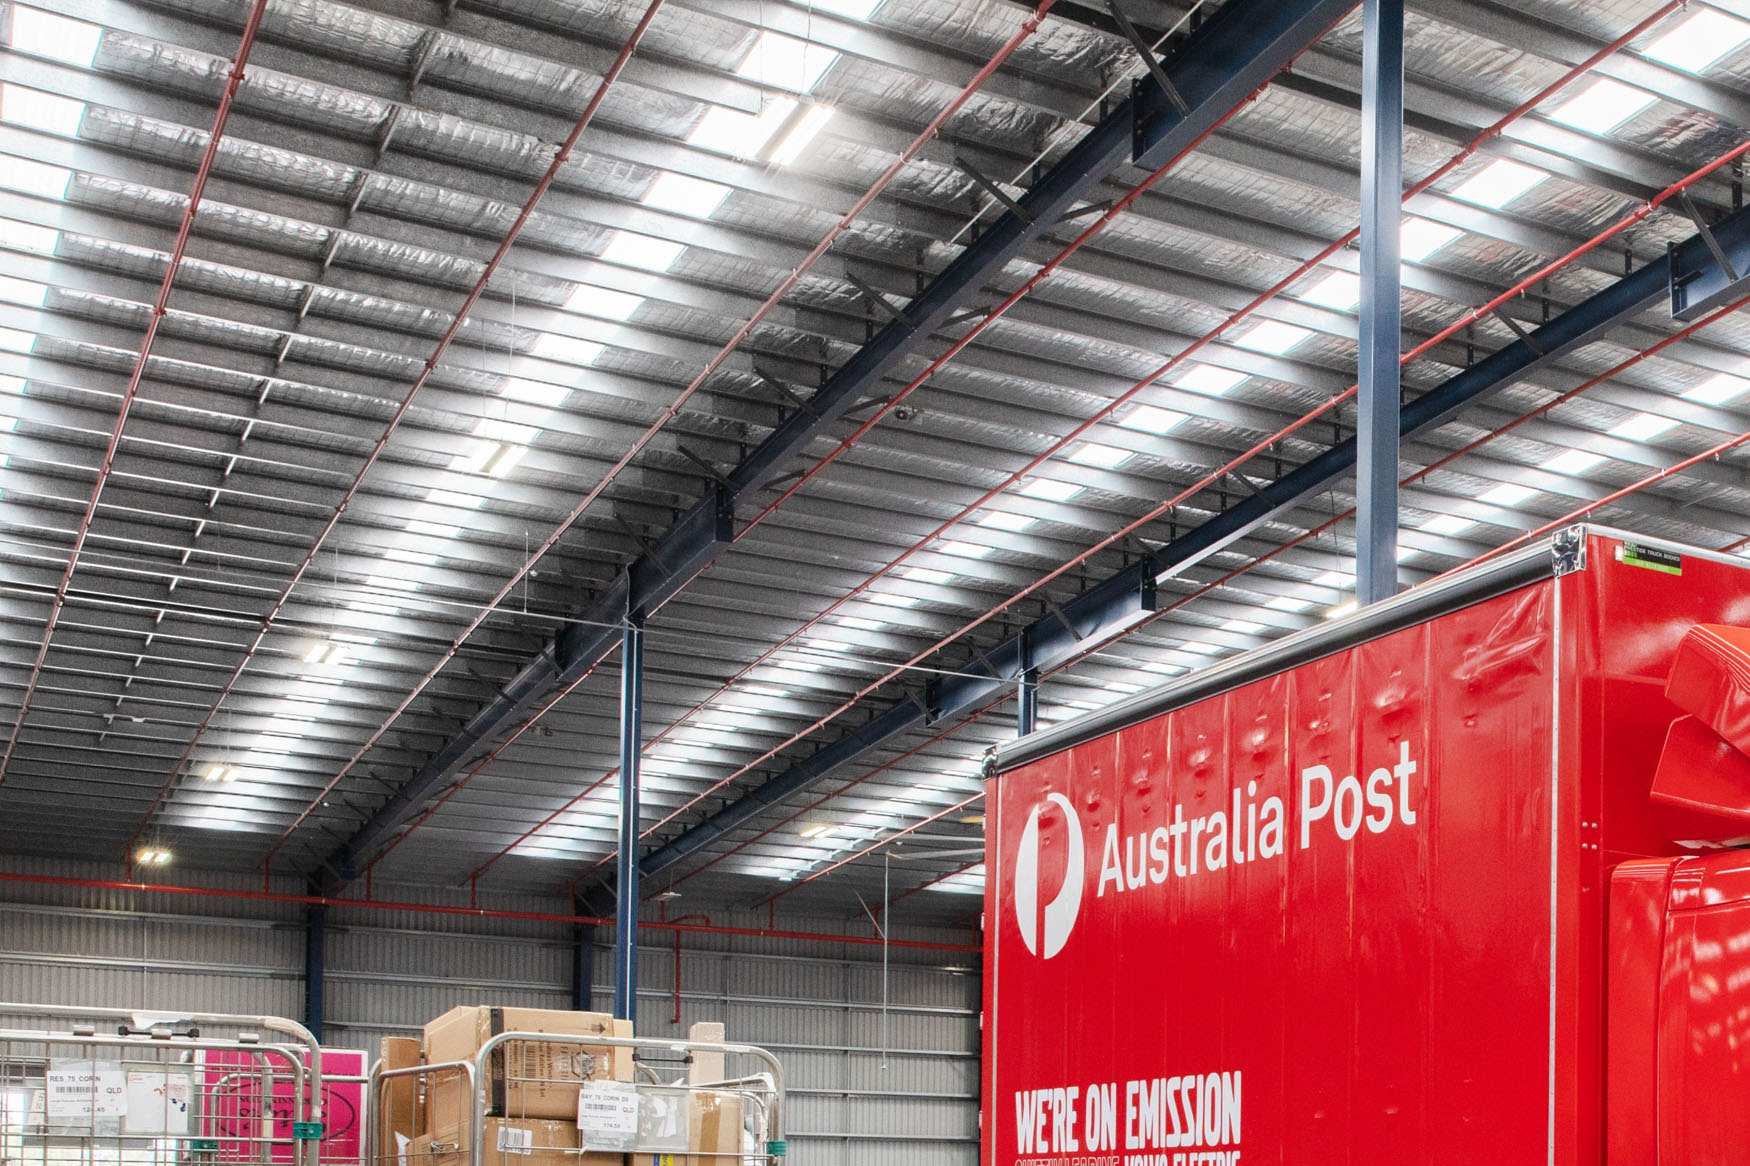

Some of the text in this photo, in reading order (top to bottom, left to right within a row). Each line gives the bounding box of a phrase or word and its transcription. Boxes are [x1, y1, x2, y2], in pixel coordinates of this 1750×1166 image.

[1097, 740, 1417, 898] Australia Post
[1015, 1070, 1242, 1154] WE'RE ON EMISSION
